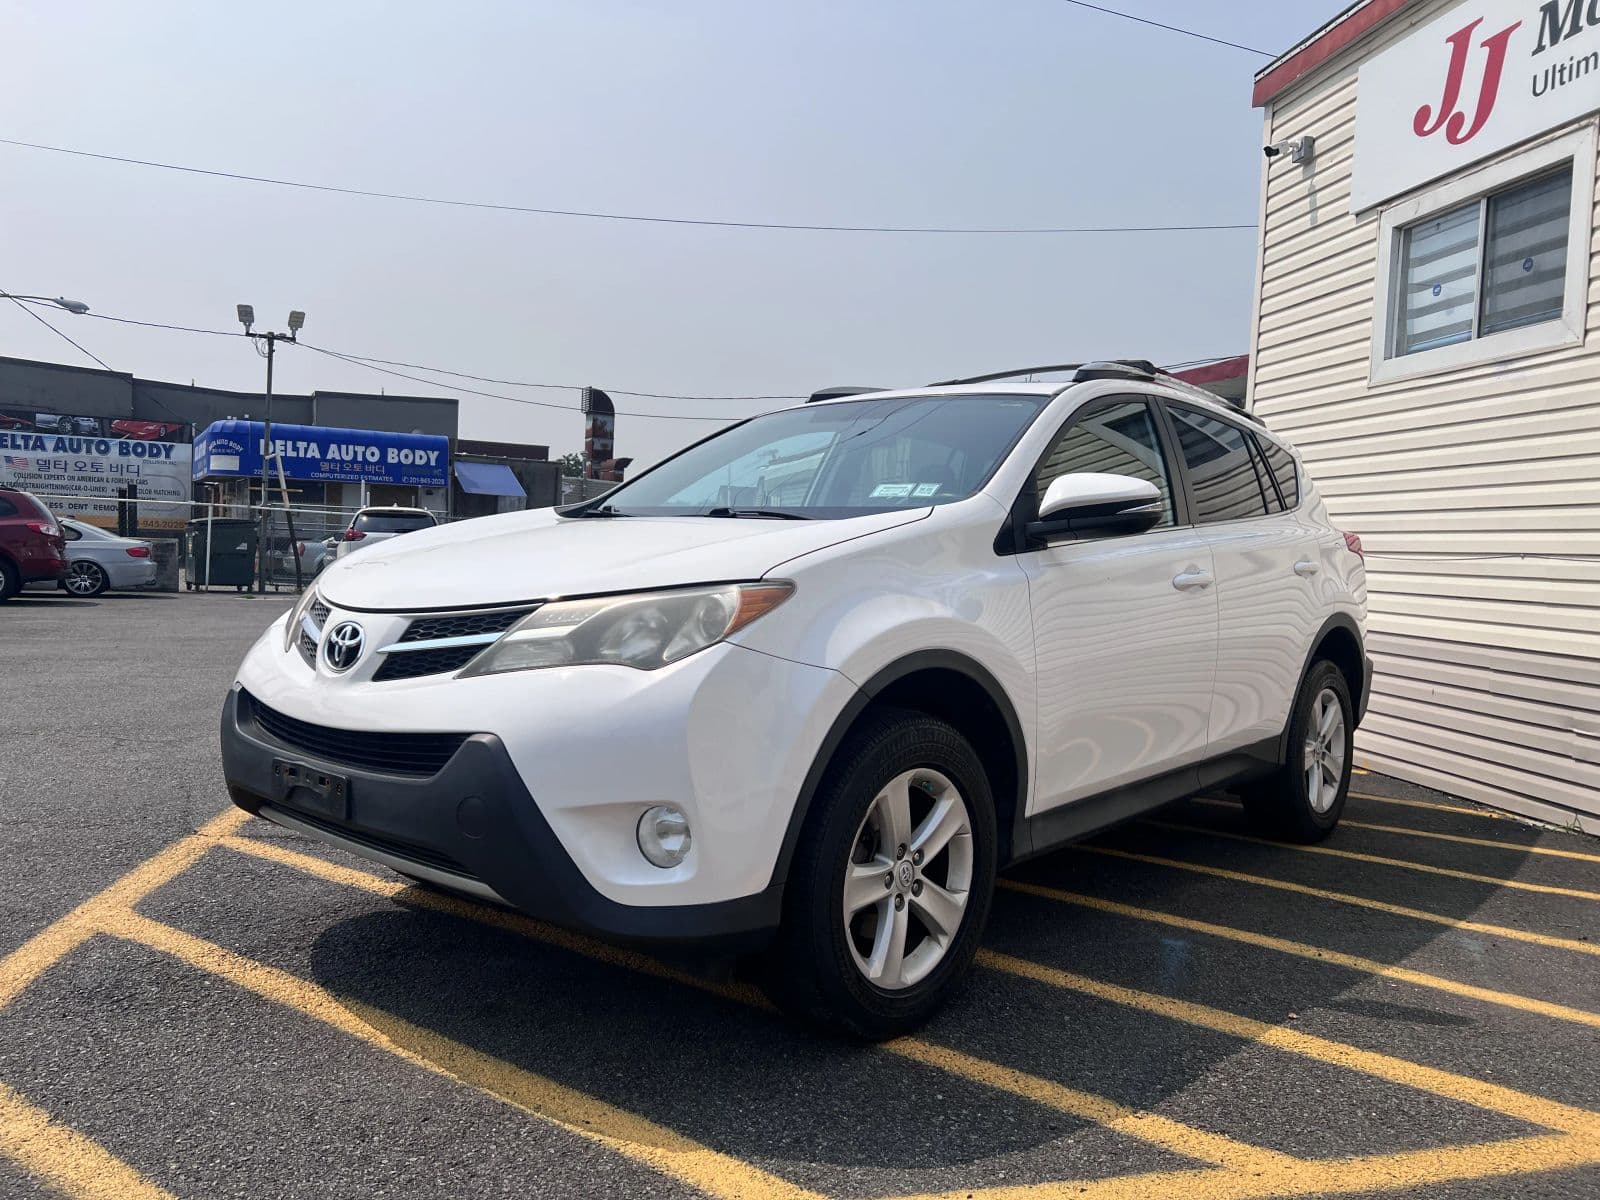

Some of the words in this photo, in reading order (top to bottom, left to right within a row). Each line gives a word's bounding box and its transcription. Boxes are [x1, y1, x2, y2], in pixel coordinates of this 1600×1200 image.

[1413, 16, 1522, 145] JJ
[1532, 51, 1599, 97] Ultim
[52, 436, 111, 456] AUTO
[118, 440, 175, 460] BODY
[259, 438, 321, 459] DELTA
[326, 443, 380, 462] AUTO
[387, 447, 440, 466] BODY
[14, 471, 43, 480] COLLISION
[44, 473, 66, 481] EXPERTS
[77, 475, 104, 483] AMERICAN
[74, 460, 105, 473] 오토
[109, 463, 140, 477] 바디
[311, 471, 359, 480] COMPUTERIZED
[360, 474, 393, 482] ESTIMATES
[343, 462, 363, 472] 오토
[365, 464, 385, 475] 바디
[68, 502, 89, 510] DENT
